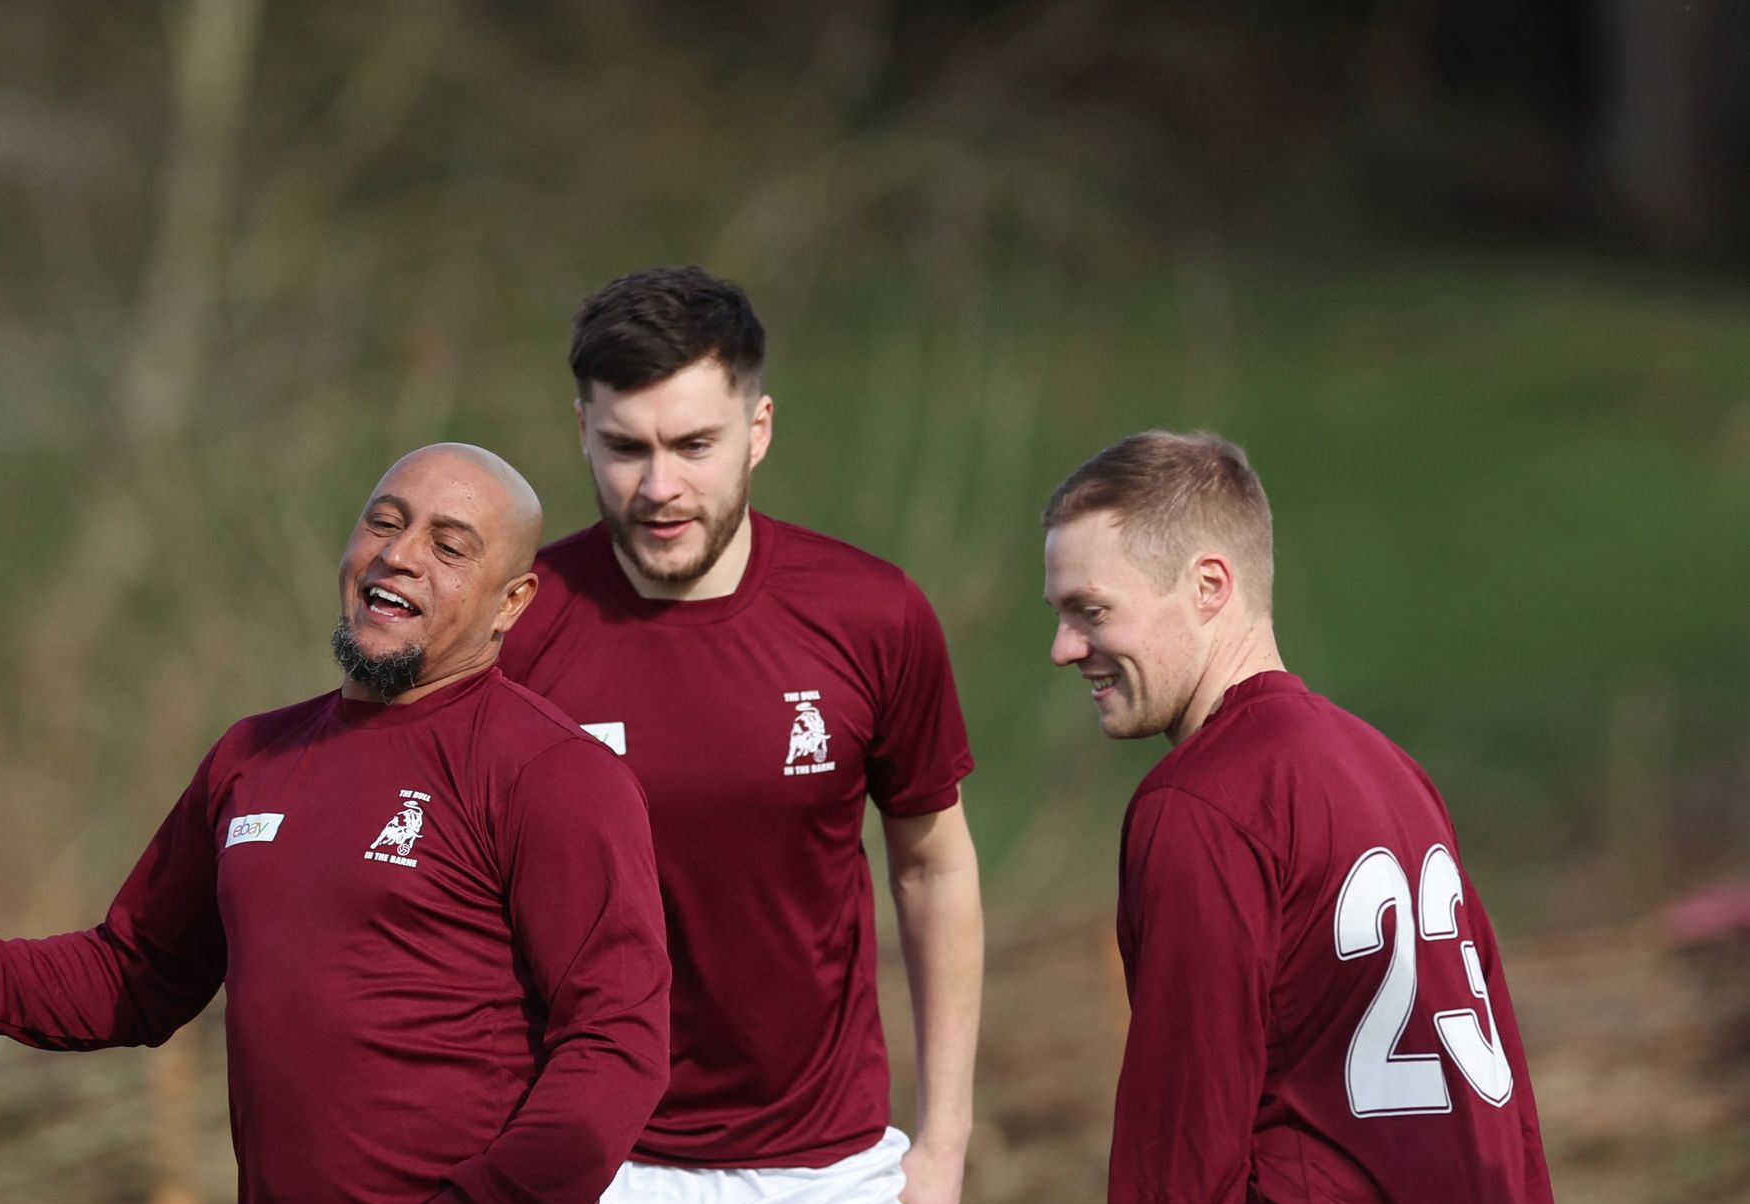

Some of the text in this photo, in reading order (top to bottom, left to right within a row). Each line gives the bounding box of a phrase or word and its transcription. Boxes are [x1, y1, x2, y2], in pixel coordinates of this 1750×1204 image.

[399, 789, 431, 802] THE BULL
[233, 818, 269, 838] ebay
[364, 850, 374, 860] IN
[374, 852, 390, 862] THE
[1333, 843, 1514, 1119] 23
